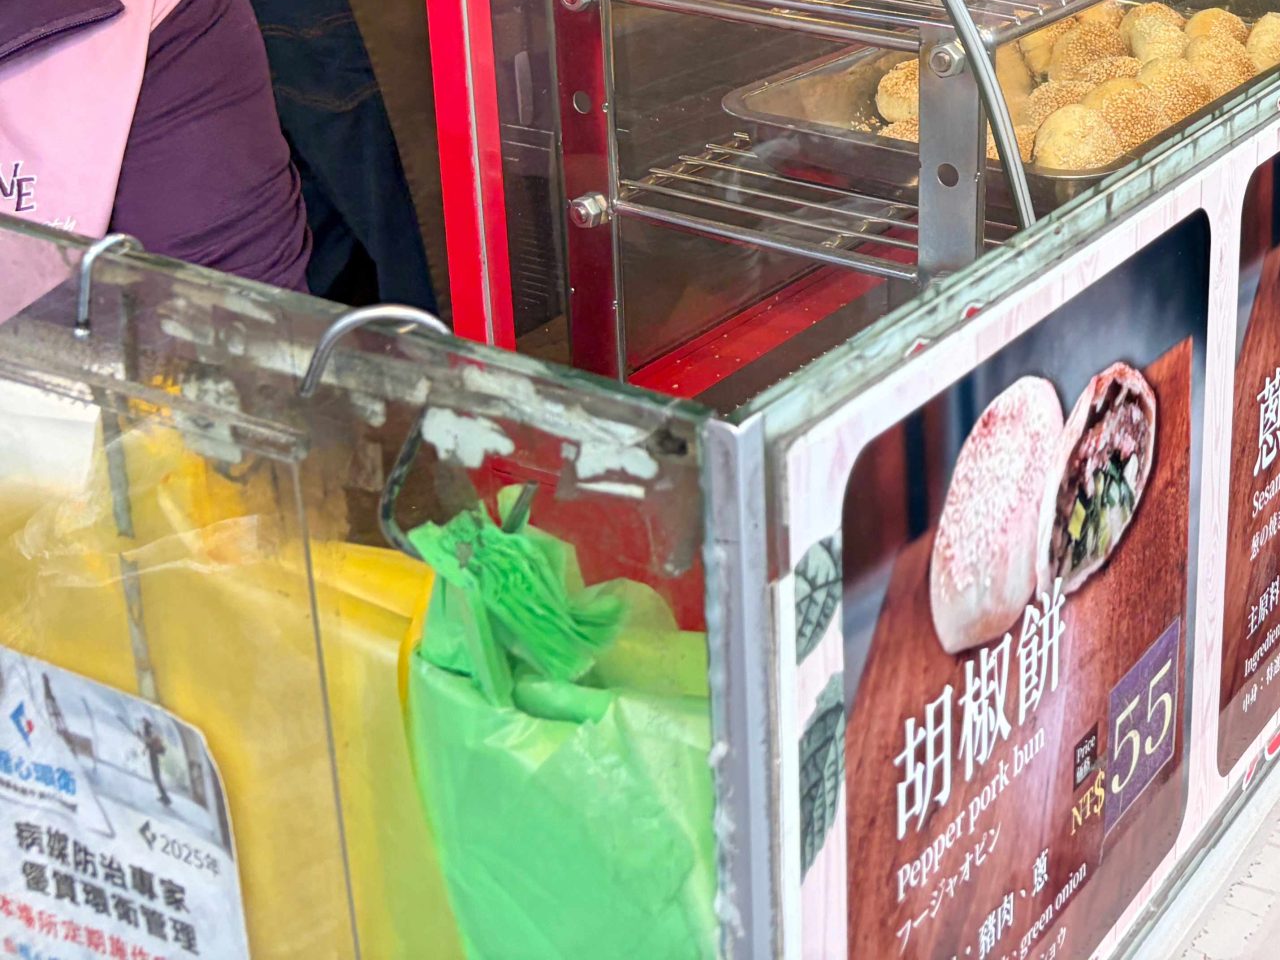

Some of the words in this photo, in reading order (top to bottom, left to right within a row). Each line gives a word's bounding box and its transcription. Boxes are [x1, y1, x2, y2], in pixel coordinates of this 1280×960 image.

[893, 577, 1066, 840] 胡椒餅
[1070, 767, 1105, 836] NT$
[1111, 658, 1173, 794] 55
[1076, 733, 1096, 764] Price
[896, 810, 966, 904] Pepper
[967, 759, 1011, 836] pork
[1012, 727, 1046, 778] bun
[1054, 862, 1088, 911] onion
